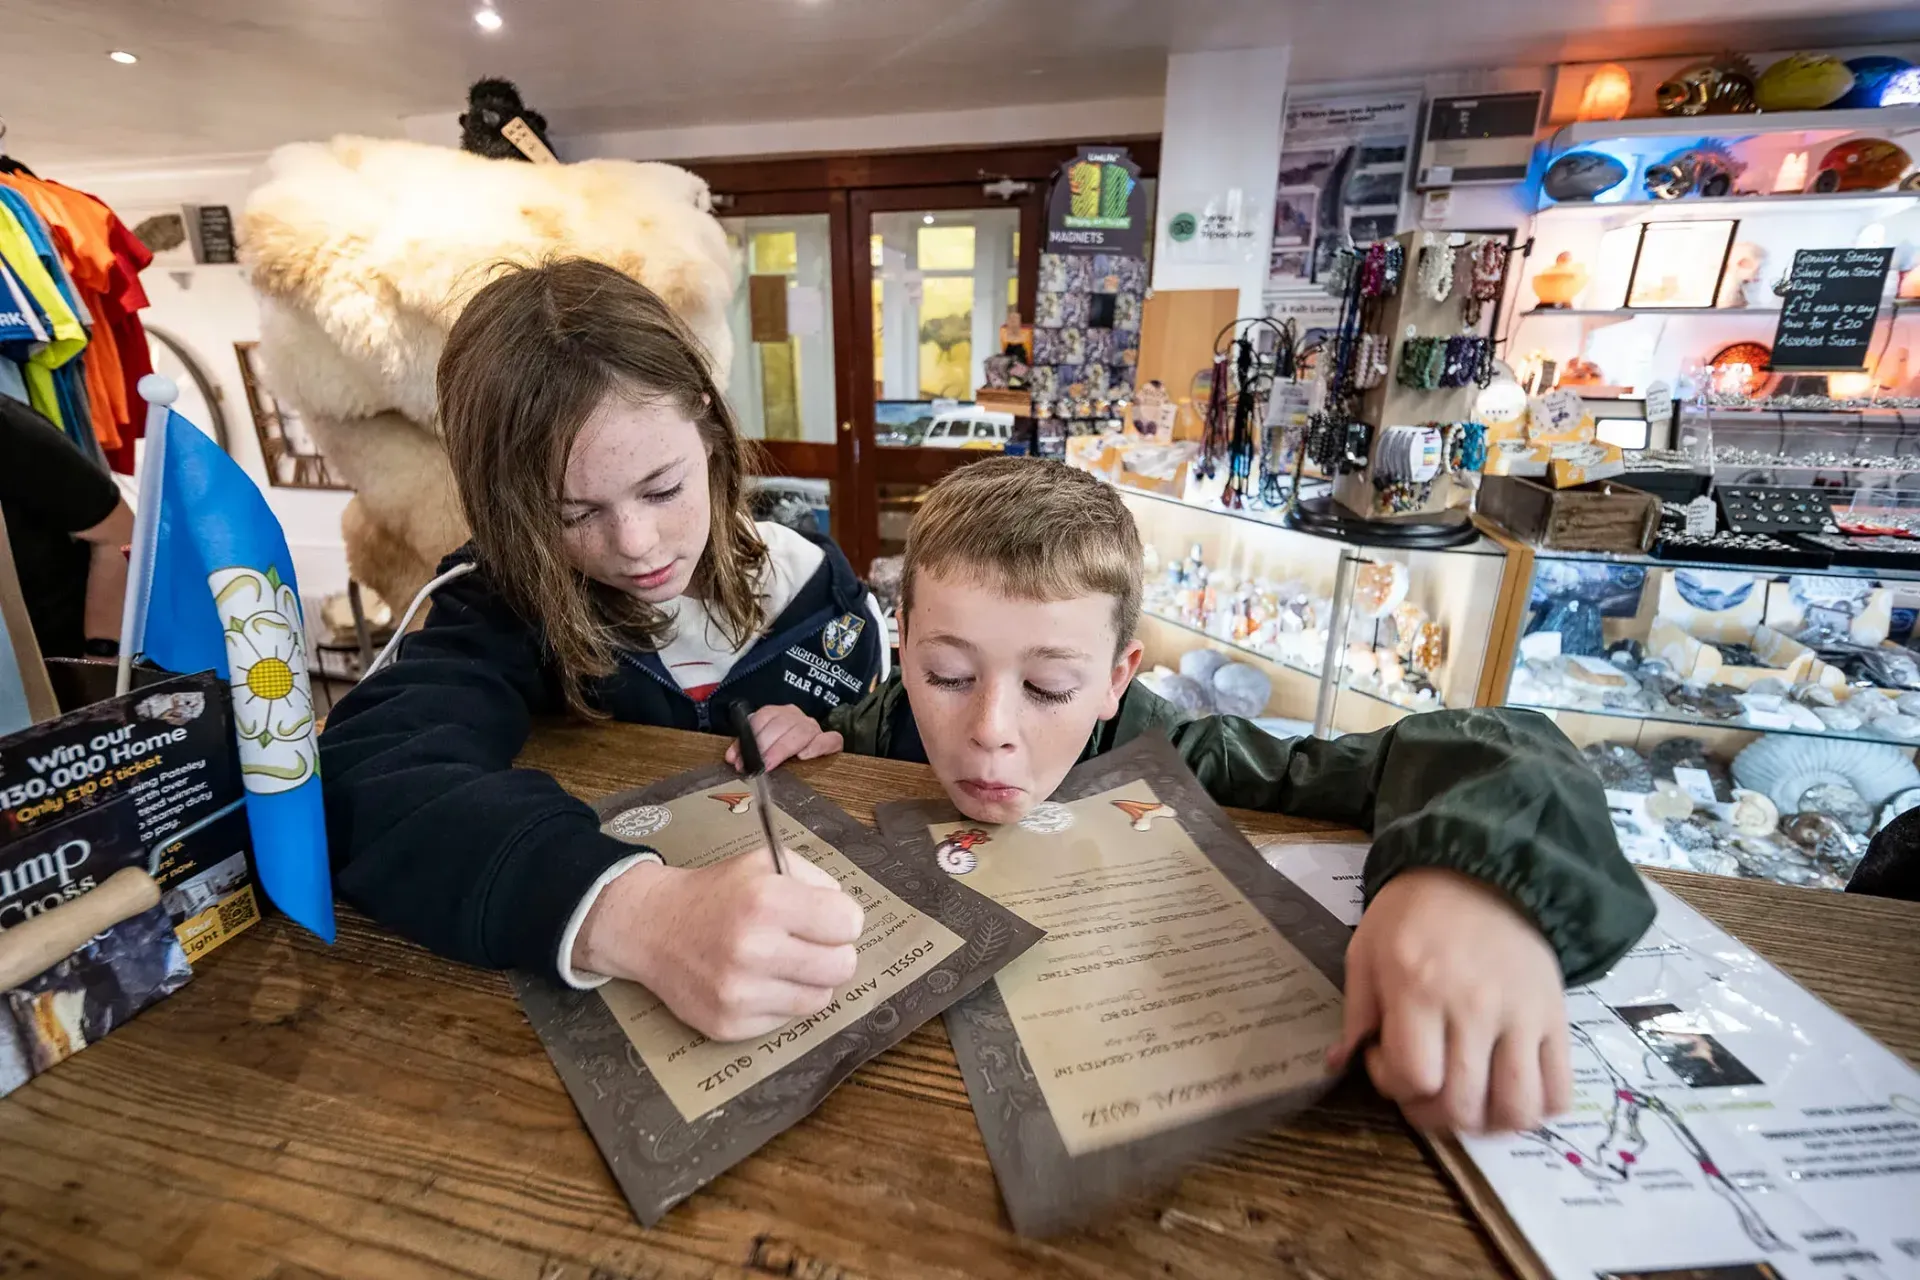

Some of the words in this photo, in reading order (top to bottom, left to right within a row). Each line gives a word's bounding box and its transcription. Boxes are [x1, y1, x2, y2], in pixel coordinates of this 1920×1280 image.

[1049, 229, 1105, 244] MAGNETS
[1807, 316, 1828, 330] for
[1832, 315, 1863, 331] £20
[1813, 303, 1841, 313] each
[783, 670, 812, 693] YEAR
[27, 743, 86, 774] Win
[89, 723, 137, 751] our
[0, 754, 107, 812] 130,000
[111, 727, 188, 765] Home
[16, 794, 65, 823] Only
[66, 780, 98, 804] £10
[99, 775, 113, 788] a
[115, 753, 164, 782] ticket
[161, 776, 190, 794] over
[146, 803, 185, 827] stamp
[185, 790, 213, 808] duty
[0, 838, 92, 900] ump
[884, 918, 907, 936] WHAT
[880, 939, 934, 982] FOSSIL
[844, 977, 879, 1004] AND
[757, 999, 842, 1058] MINERAL
[696, 1053, 754, 1094] QUIZ
